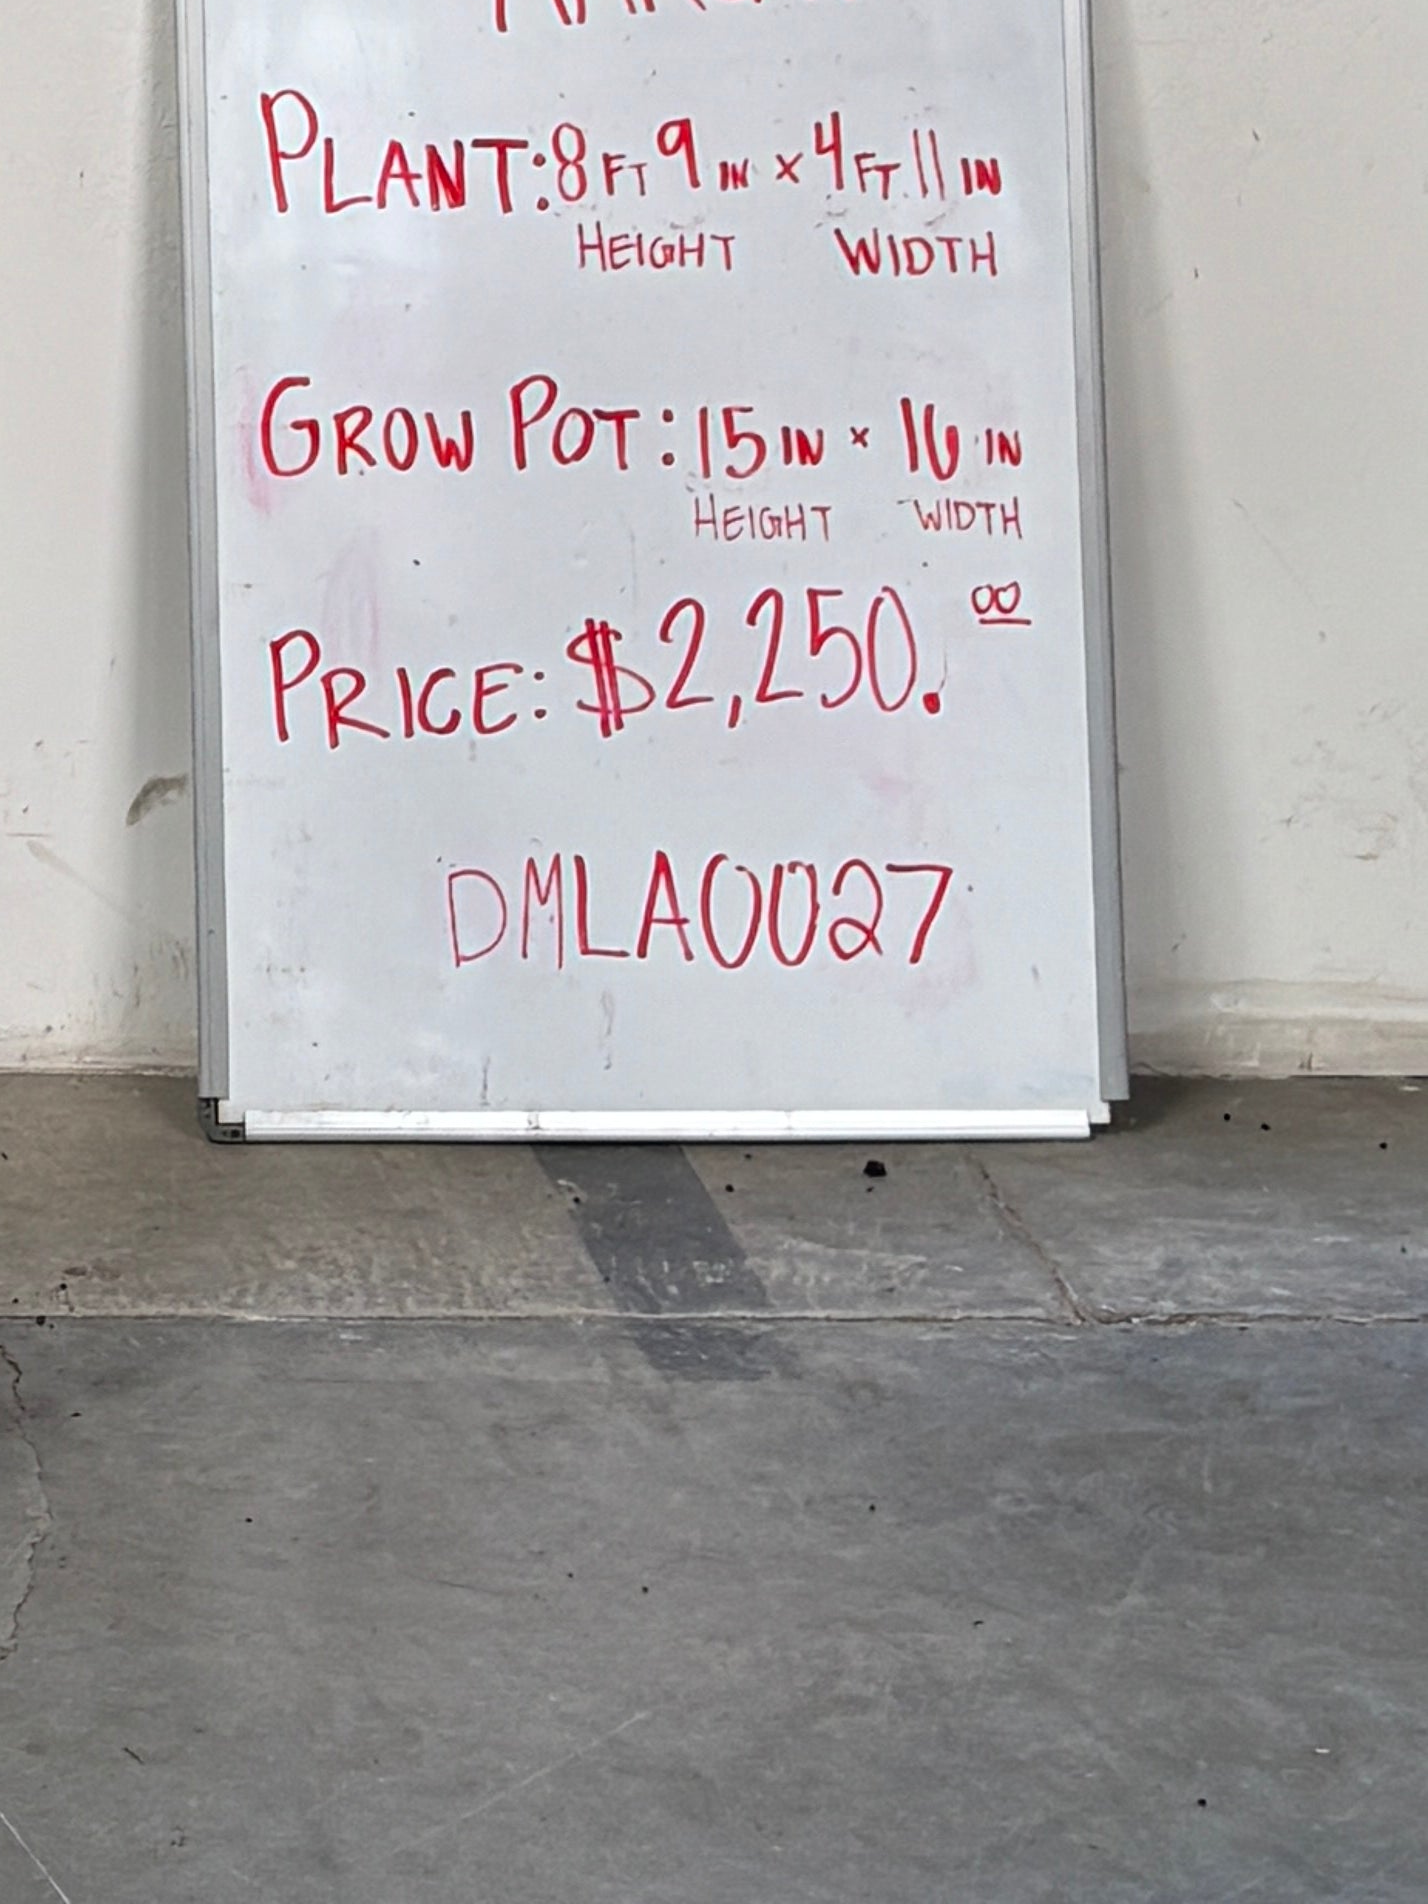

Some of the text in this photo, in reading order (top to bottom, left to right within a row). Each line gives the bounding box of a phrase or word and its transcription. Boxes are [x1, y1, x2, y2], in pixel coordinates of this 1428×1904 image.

[577, 221, 999, 278] HEIGHT WIDTH
[260, 376, 475, 480] GROW
[694, 492, 1023, 543] HEIGHT WIDTH
[446, 849, 955, 971] DMLA0027
